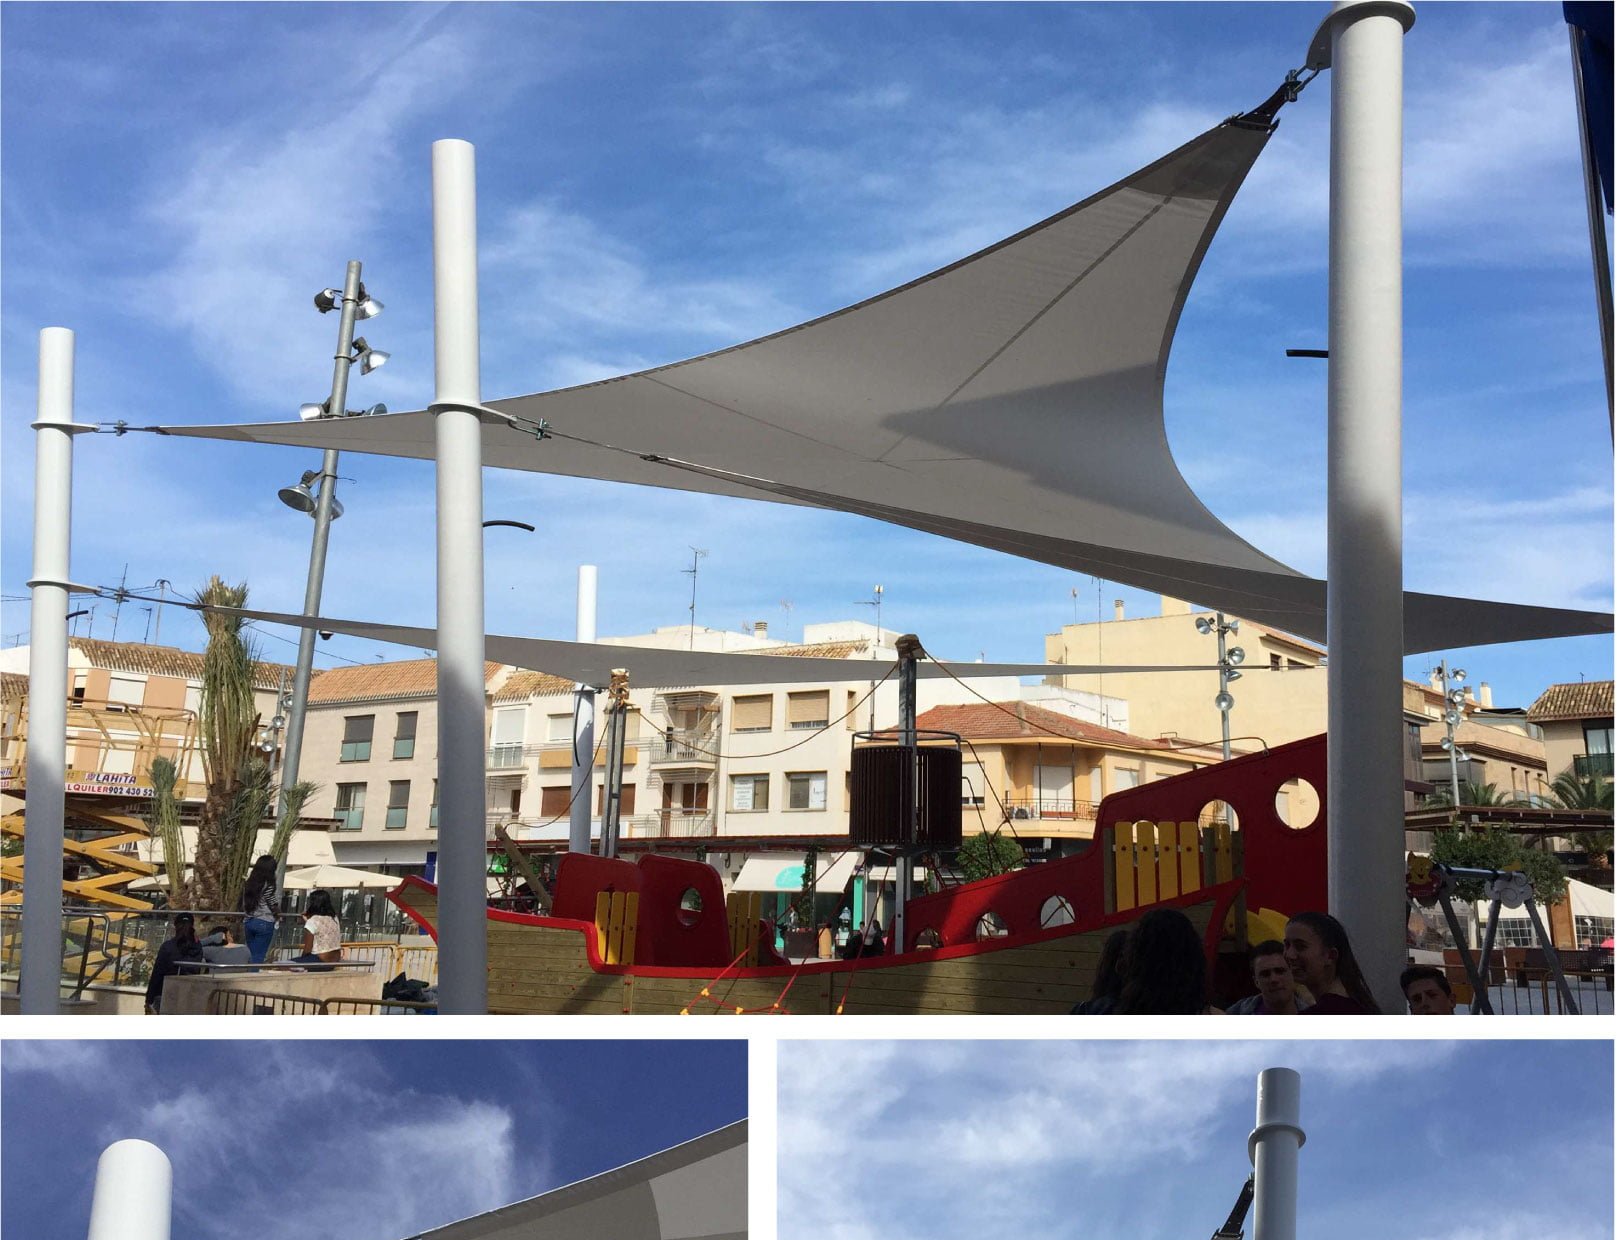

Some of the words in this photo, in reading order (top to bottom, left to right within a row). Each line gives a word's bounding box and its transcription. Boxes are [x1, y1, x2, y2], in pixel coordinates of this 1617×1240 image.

[95, 773, 137, 784] LAHITA
[66, 783, 109, 793] LQUILER
[108, 787, 123, 795] 902
[126, 788, 141, 796] 430
